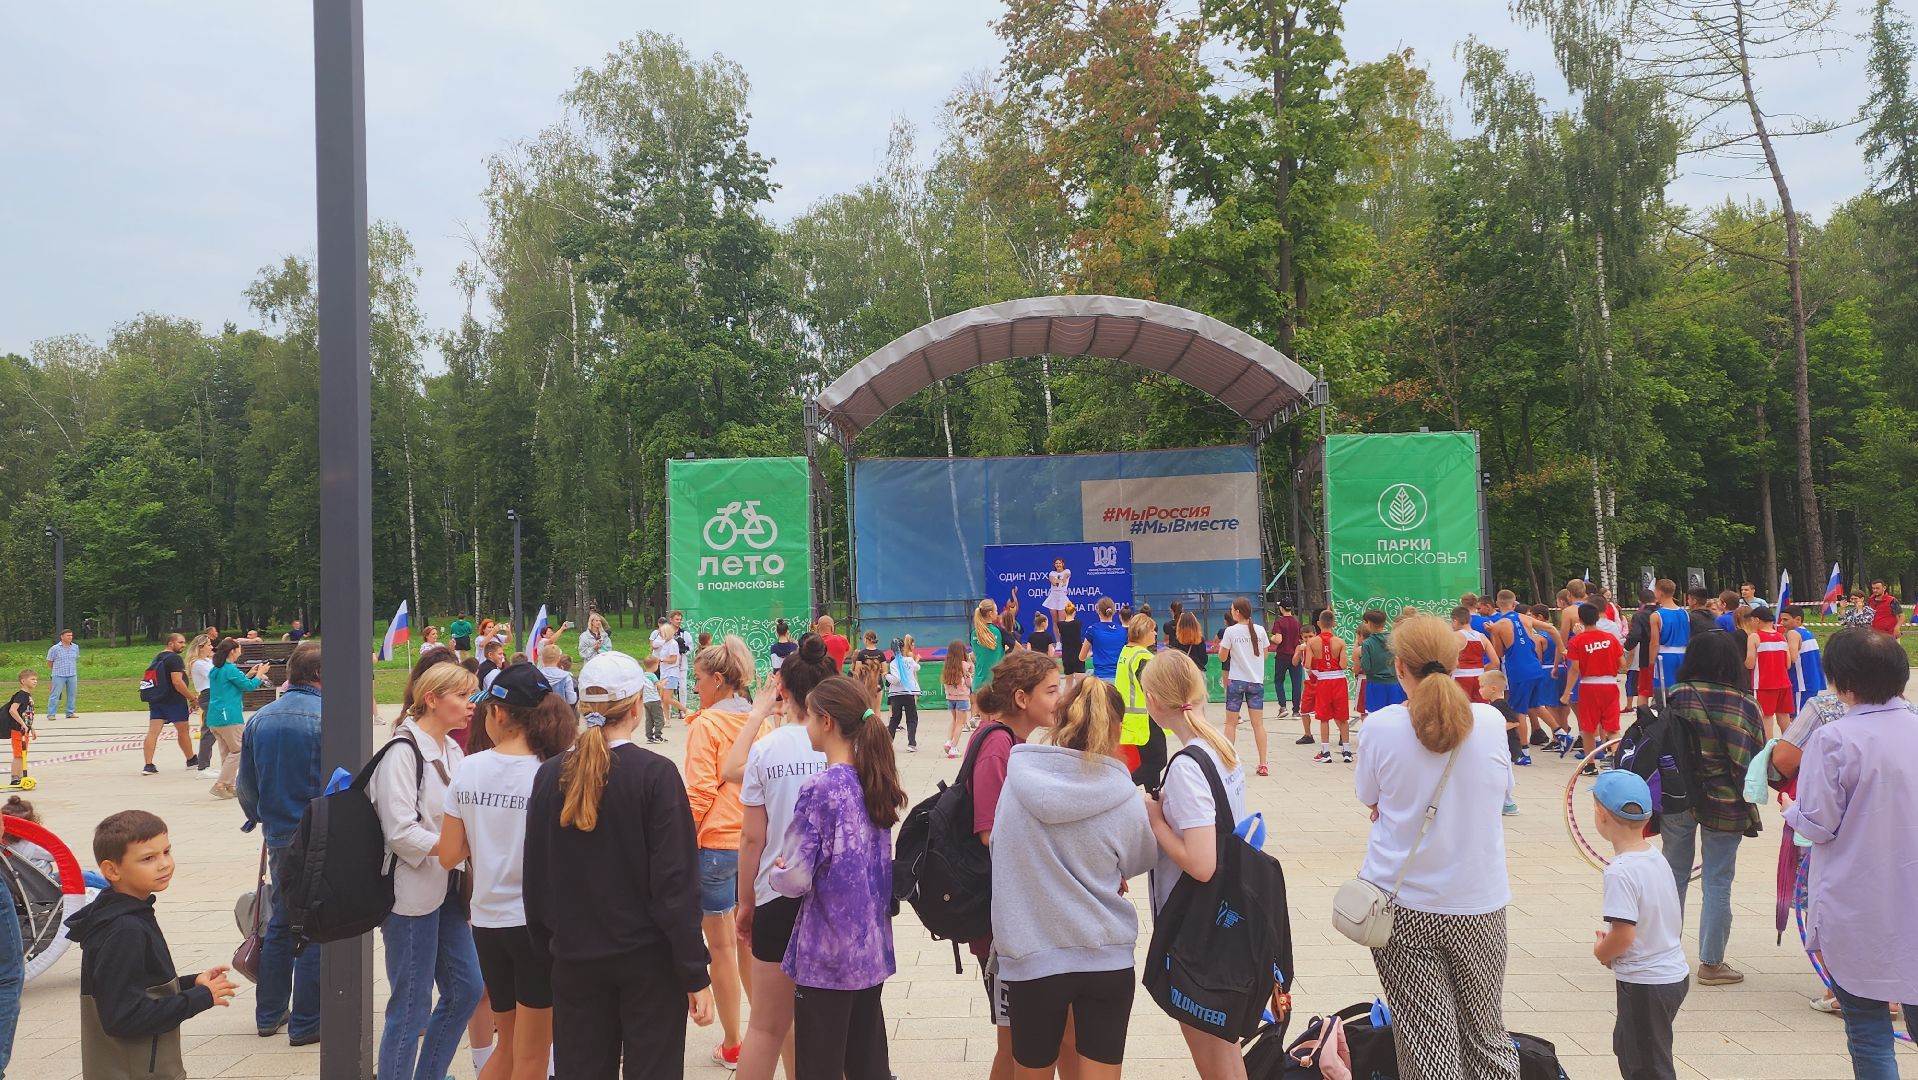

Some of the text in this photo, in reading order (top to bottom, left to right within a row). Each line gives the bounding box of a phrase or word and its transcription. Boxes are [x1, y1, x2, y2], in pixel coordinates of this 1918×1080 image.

[1103, 505, 1211, 522] #МыРоссия
[1130, 518, 1239, 535] #МыВместе
[1377, 538, 1431, 552] ПАРКИ
[1341, 551, 1467, 566] ПОДМОСКОВЬЯ
[998, 571, 1049, 583] ОДИН ДУХ
[707, 580, 785, 592] ПОДМОСКОВЬЕ
[766, 761, 828, 780] ИВАНТЕ
[1170, 985, 1227, 1027] OLUNTEER
